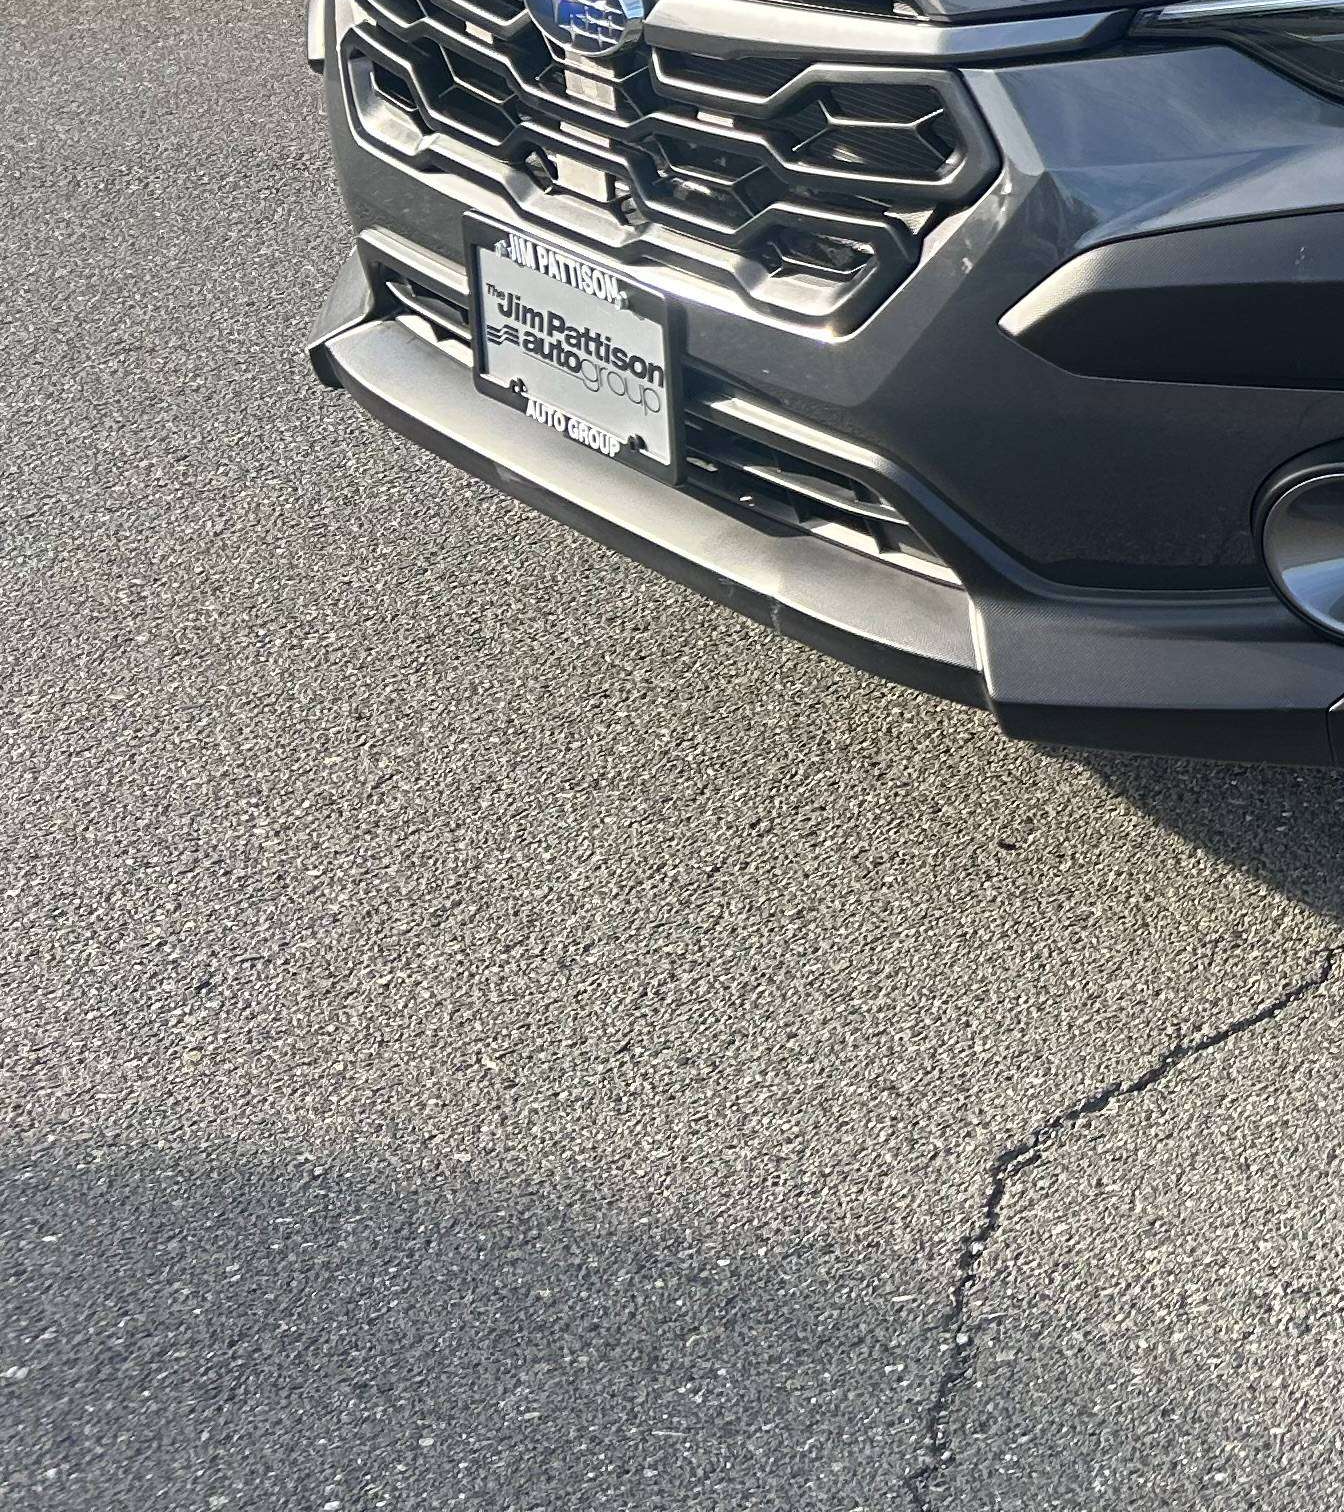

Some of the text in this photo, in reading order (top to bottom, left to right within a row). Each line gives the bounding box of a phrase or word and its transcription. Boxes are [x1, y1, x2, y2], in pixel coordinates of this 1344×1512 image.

[486, 282, 506, 302] The
[507, 233, 619, 303] JIM PATTISON
[525, 398, 621, 458] AUTO GROUP
